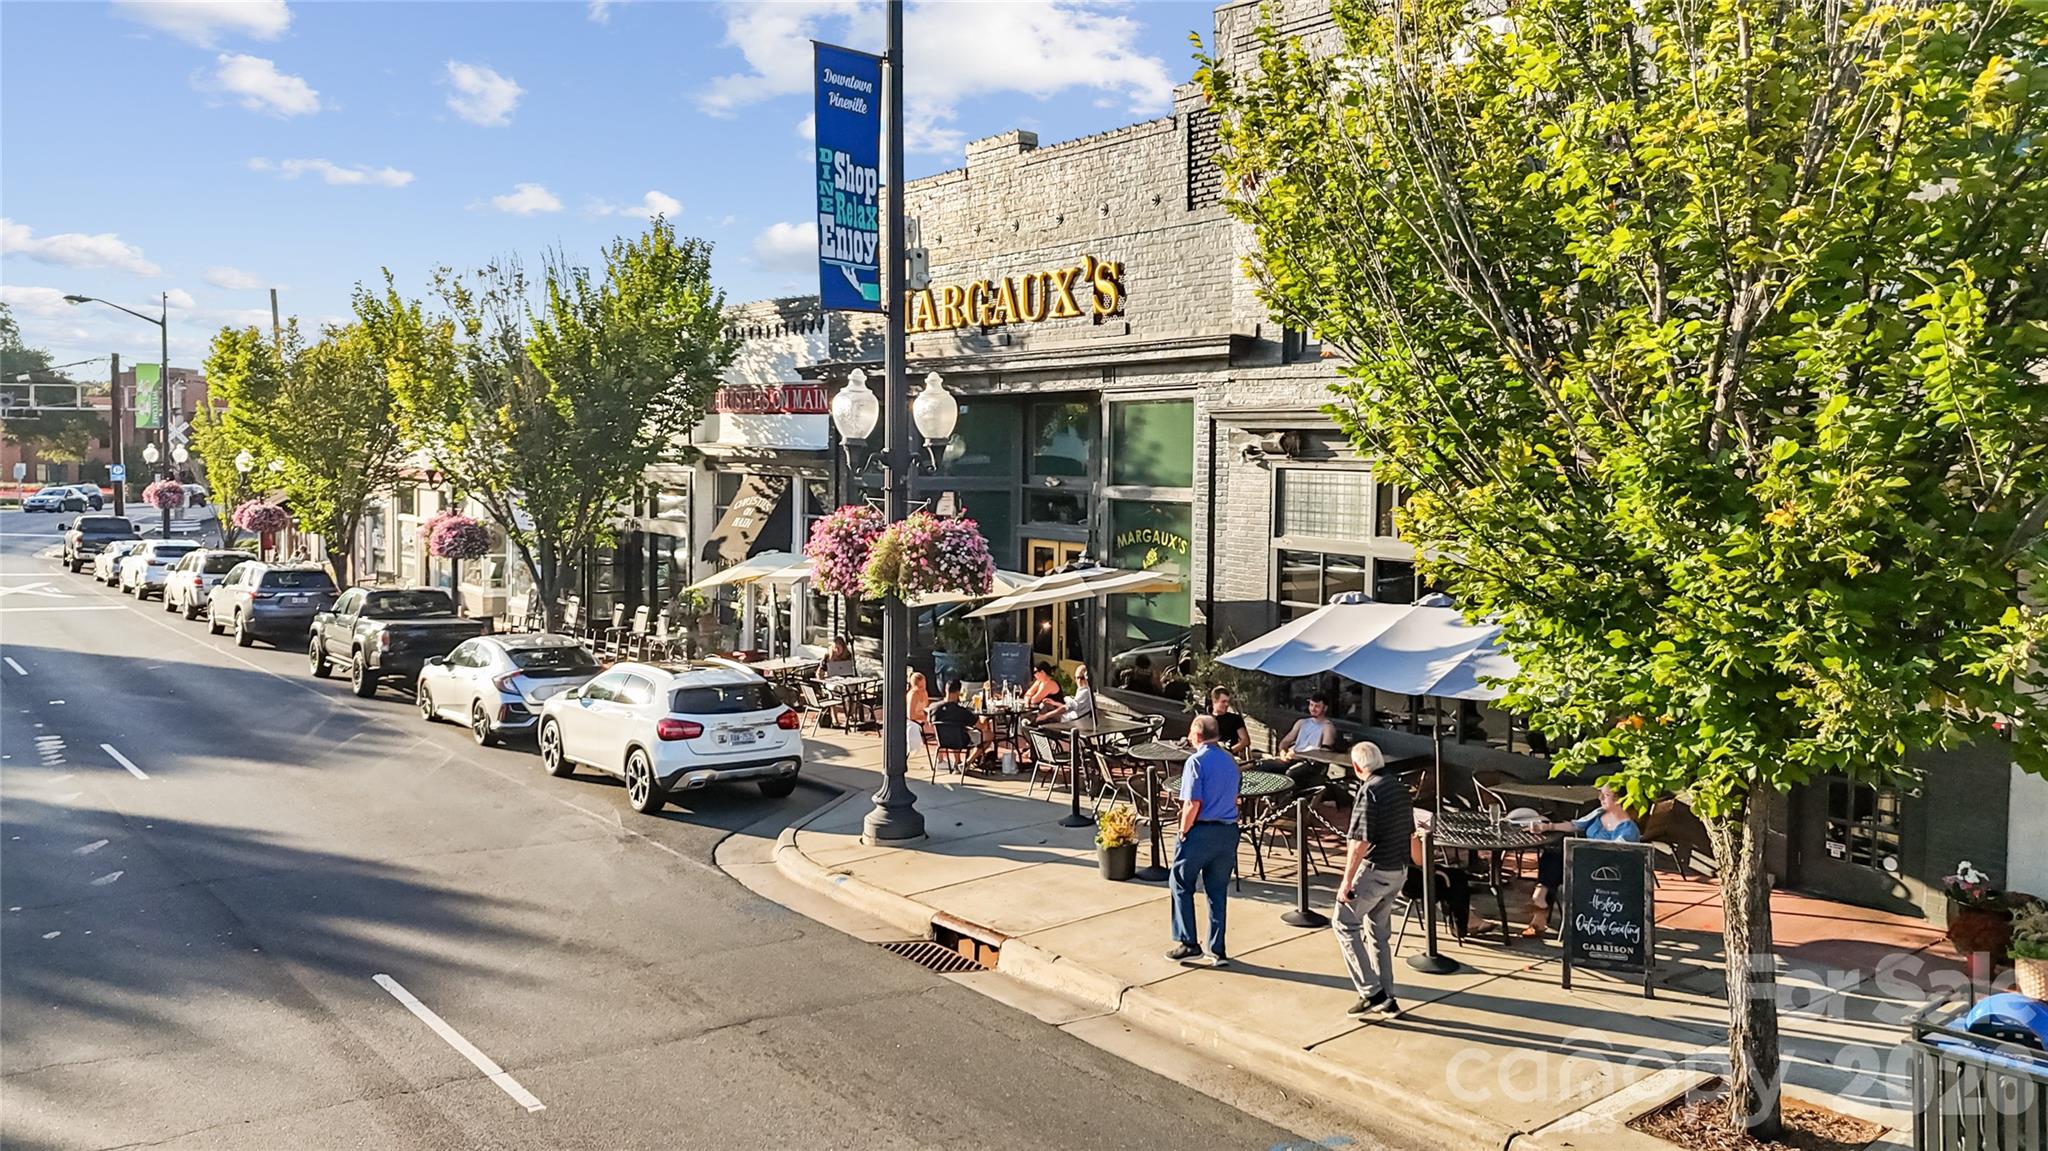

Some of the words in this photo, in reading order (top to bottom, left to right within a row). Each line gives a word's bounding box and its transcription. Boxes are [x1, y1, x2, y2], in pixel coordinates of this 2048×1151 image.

[823, 68, 872, 94] Downtown
[828, 91, 868, 114] Pineville
[819, 147, 834, 213] DINE
[834, 150, 877, 205] Shop
[834, 191, 878, 231] Relax
[820, 212, 878, 264] Enjoy
[791, 389, 828, 410] MAIN
[1117, 529, 1188, 555] MARGAUX'S
